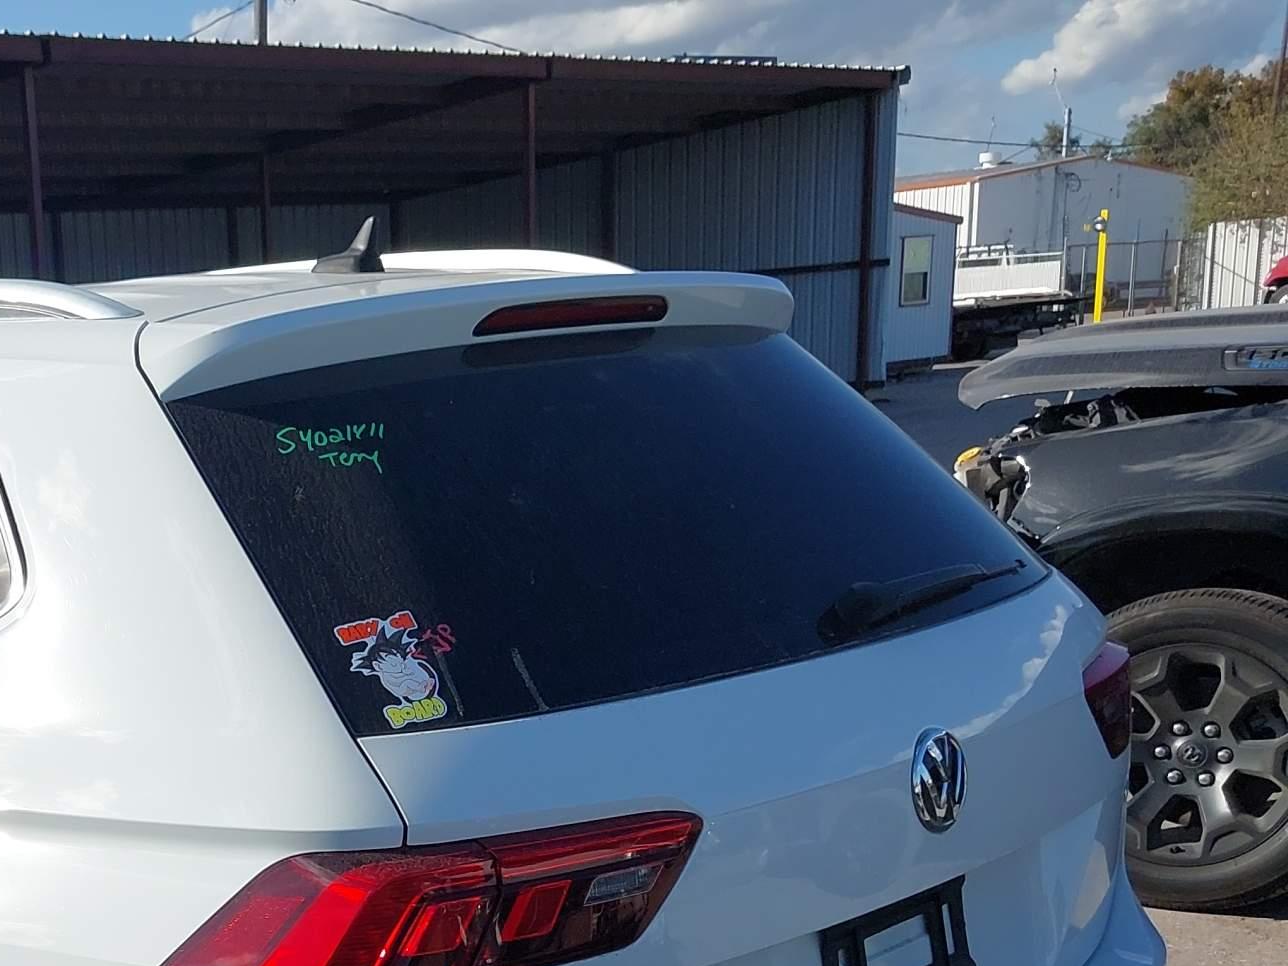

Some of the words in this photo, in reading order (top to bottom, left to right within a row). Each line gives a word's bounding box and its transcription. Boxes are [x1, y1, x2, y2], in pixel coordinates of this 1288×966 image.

[337, 619, 379, 645] BABY
[388, 612, 417, 630] ON
[385, 697, 446, 727] BOARD
